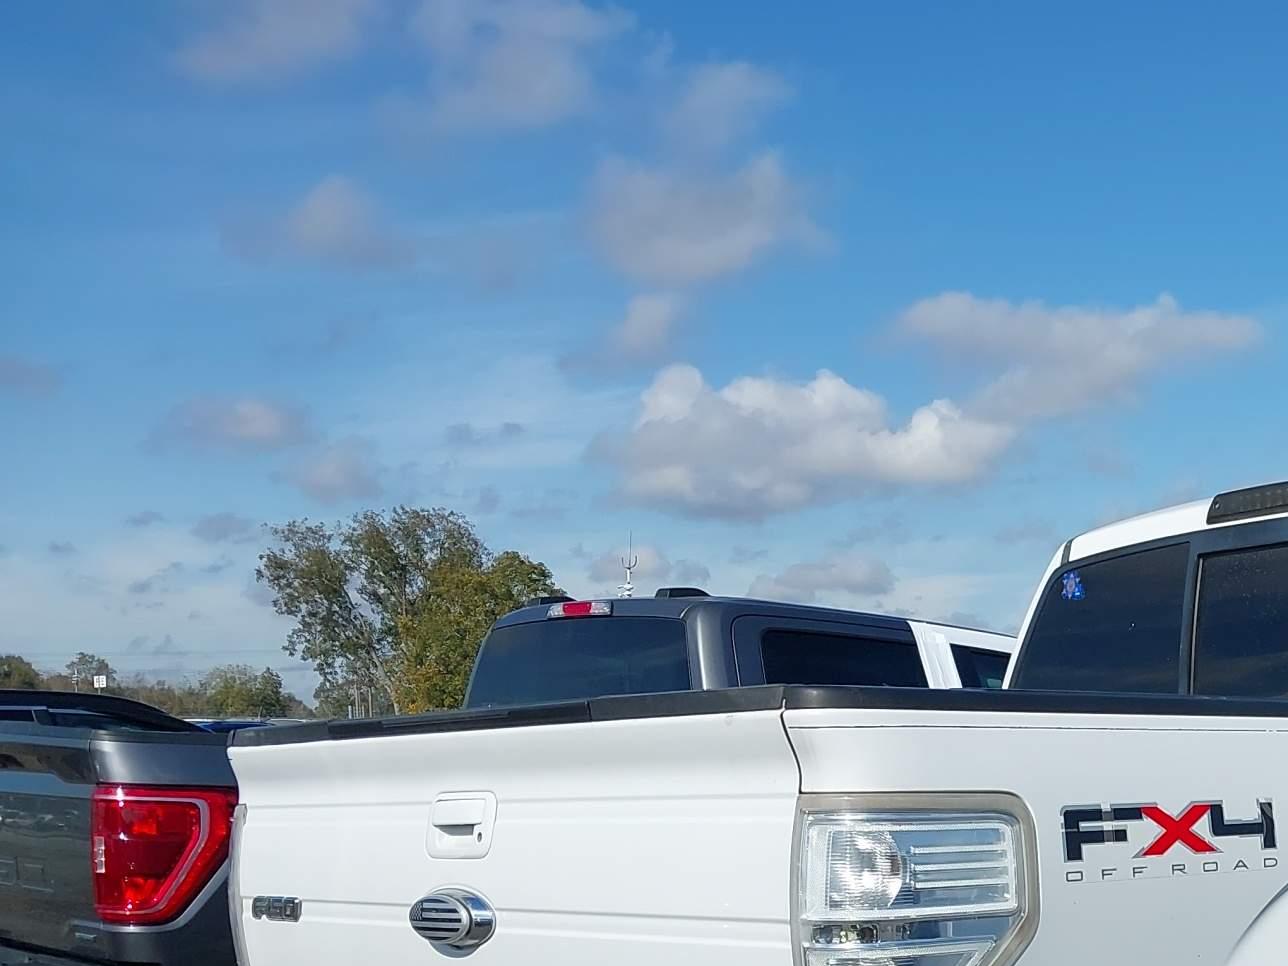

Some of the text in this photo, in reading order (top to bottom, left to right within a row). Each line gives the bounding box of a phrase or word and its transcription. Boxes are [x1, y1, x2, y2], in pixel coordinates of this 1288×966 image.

[1060, 797, 1278, 864] FX4
[1065, 857, 1279, 883] OFF ROAD
